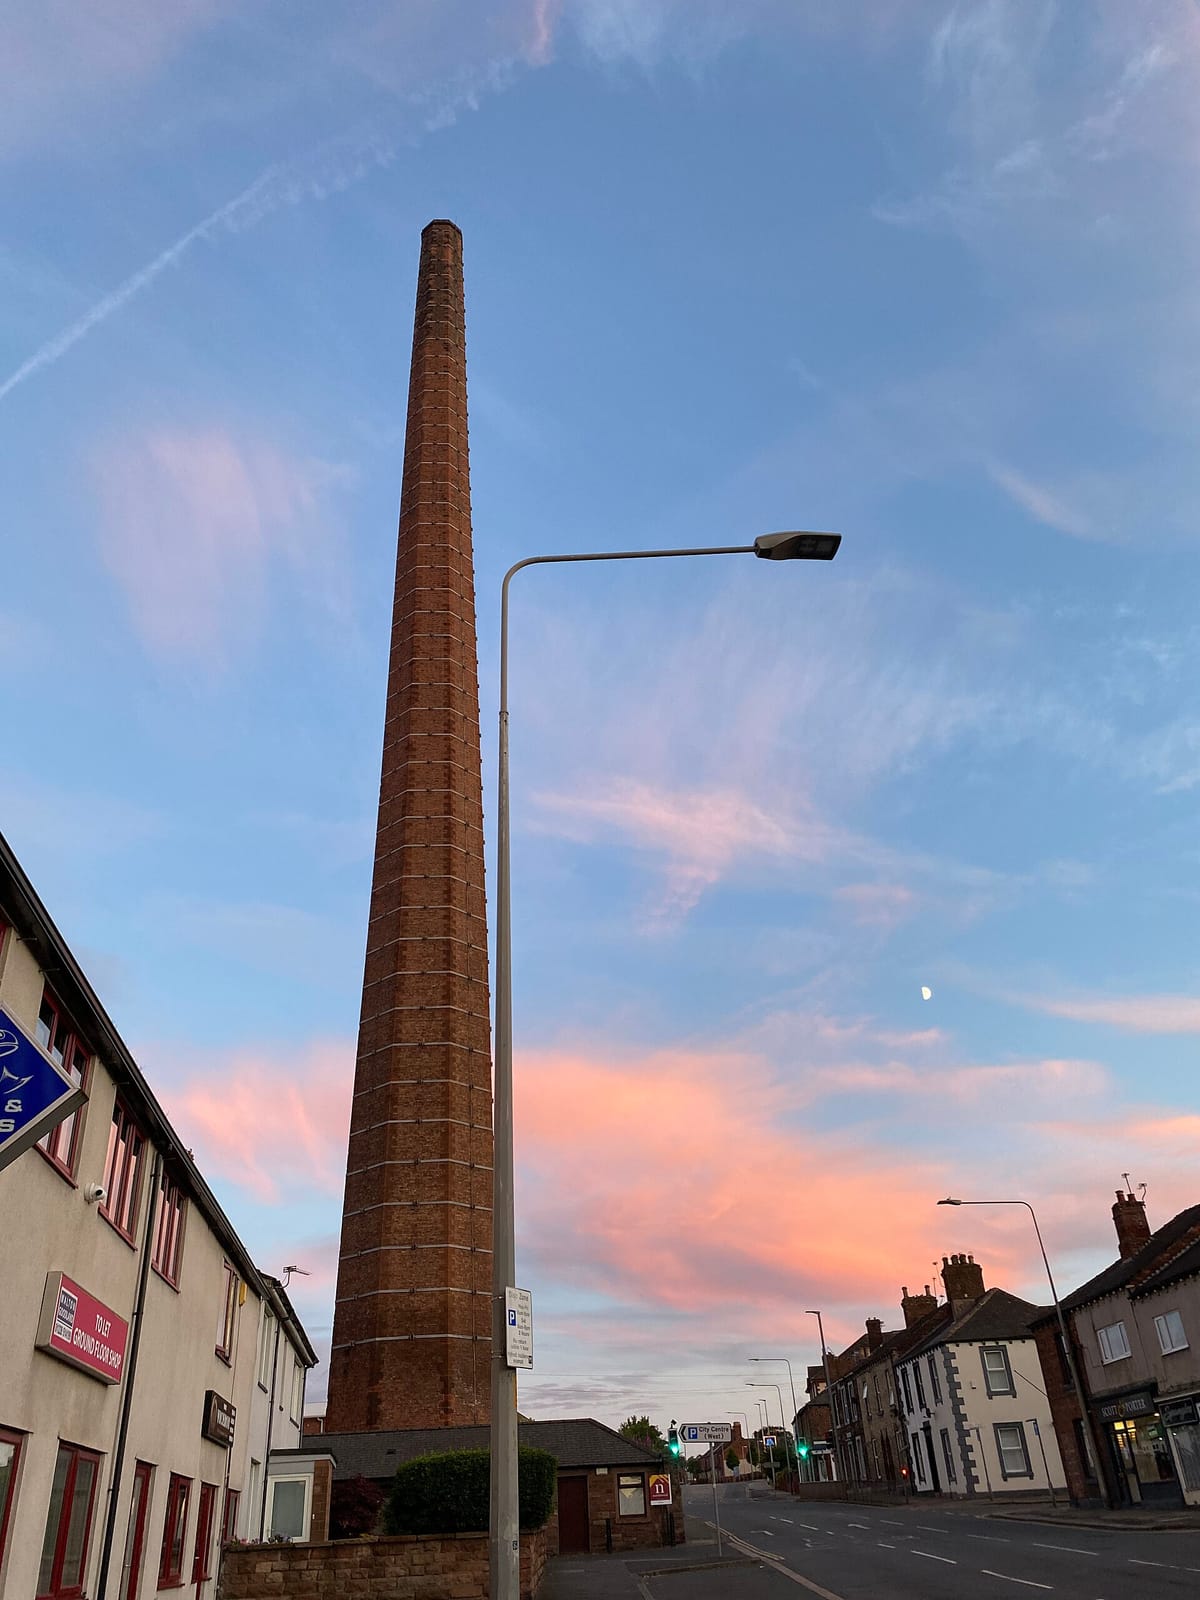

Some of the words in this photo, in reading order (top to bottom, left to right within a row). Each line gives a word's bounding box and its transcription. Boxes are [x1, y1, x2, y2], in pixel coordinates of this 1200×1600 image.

[4, 1099, 23, 1113] &
[95, 1314, 103, 1333] TO
[102, 1319, 111, 1338] LET
[73, 1327, 95, 1355] GROUND
[94, 1340, 109, 1363] FLOOR
[108, 1349, 122, 1370] SHOP
[1101, 1405, 1118, 1417] SCOTT
[1125, 1398, 1147, 1412] PORTER
